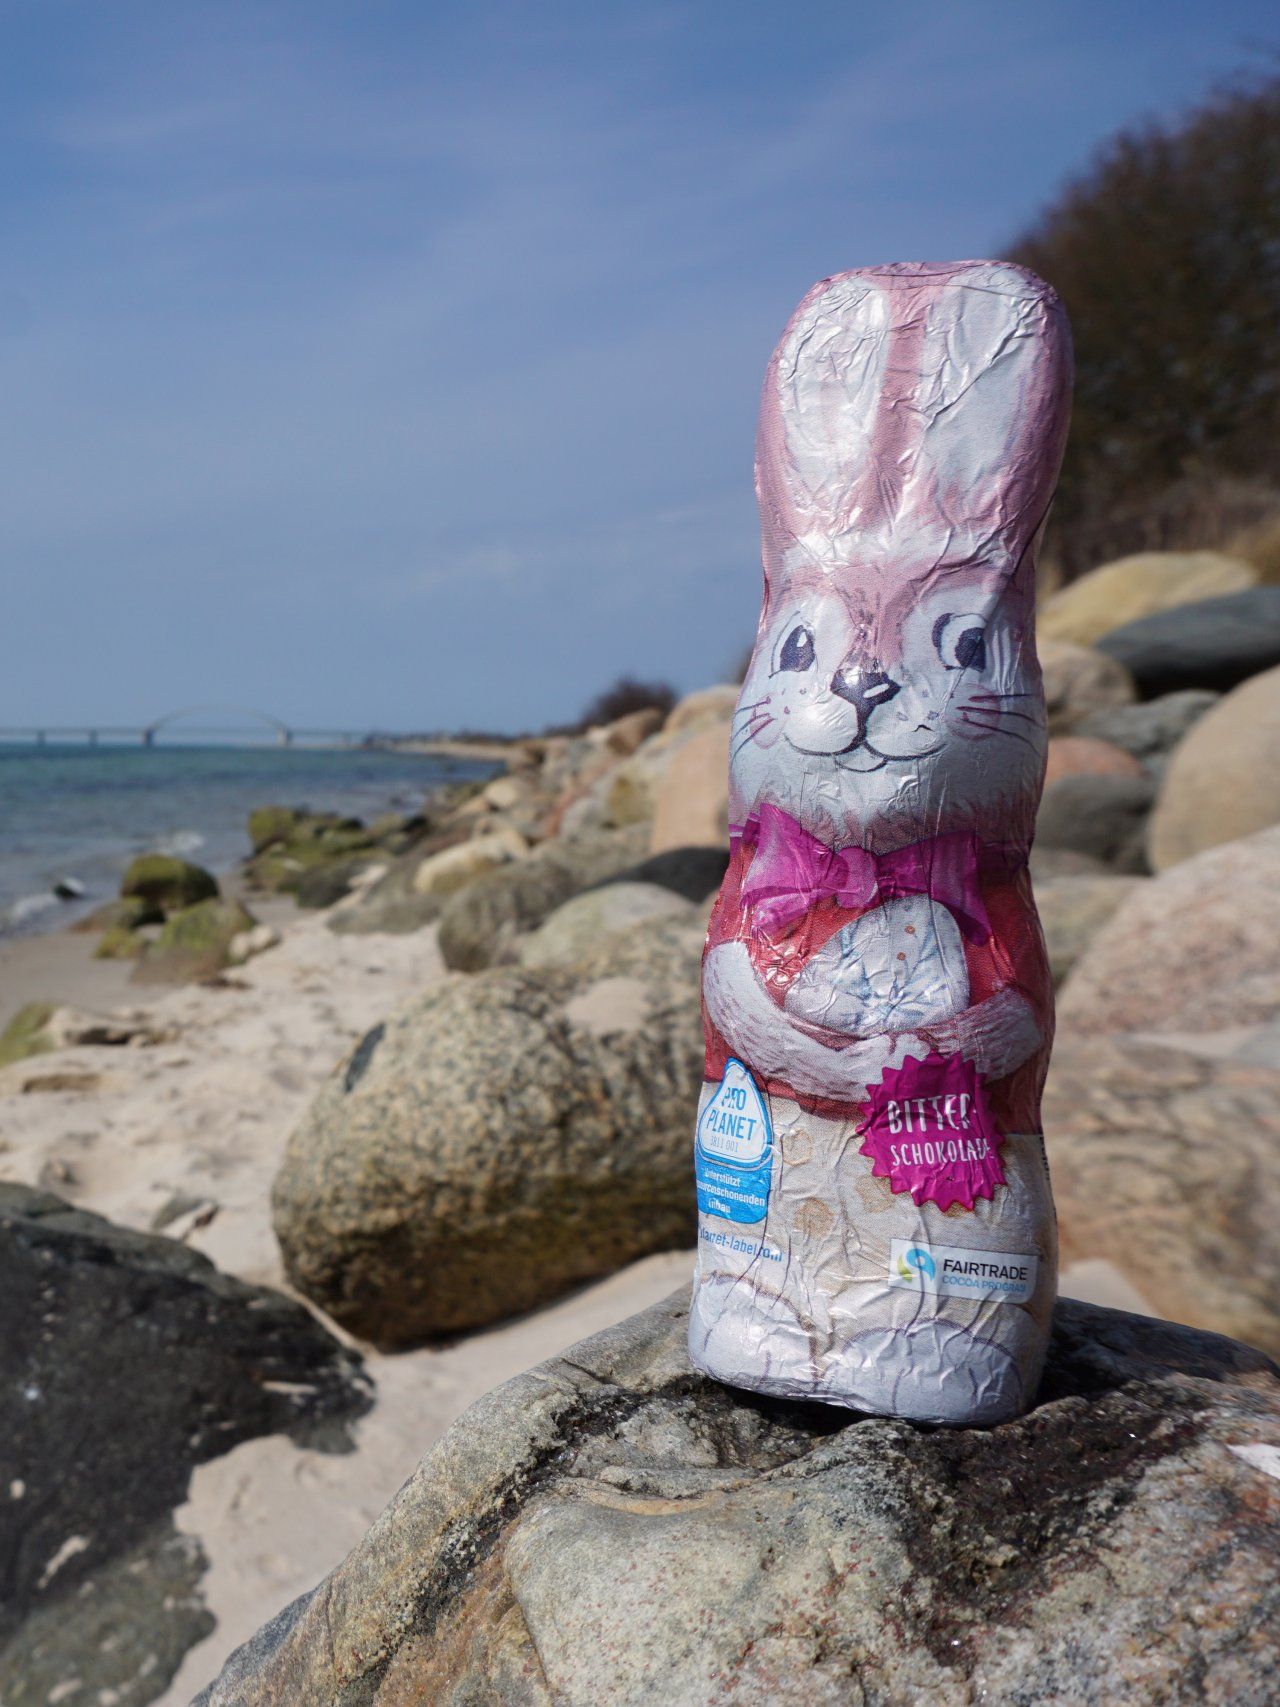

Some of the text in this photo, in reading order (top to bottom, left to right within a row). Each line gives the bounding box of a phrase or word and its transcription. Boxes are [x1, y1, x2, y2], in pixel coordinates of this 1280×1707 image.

[706, 1109, 757, 1141] PLANET
[890, 1138, 995, 1167] SCHOKOLADE
[942, 1275, 980, 1289] COCOA
[943, 1259, 1029, 1281] FAIRTRADE
